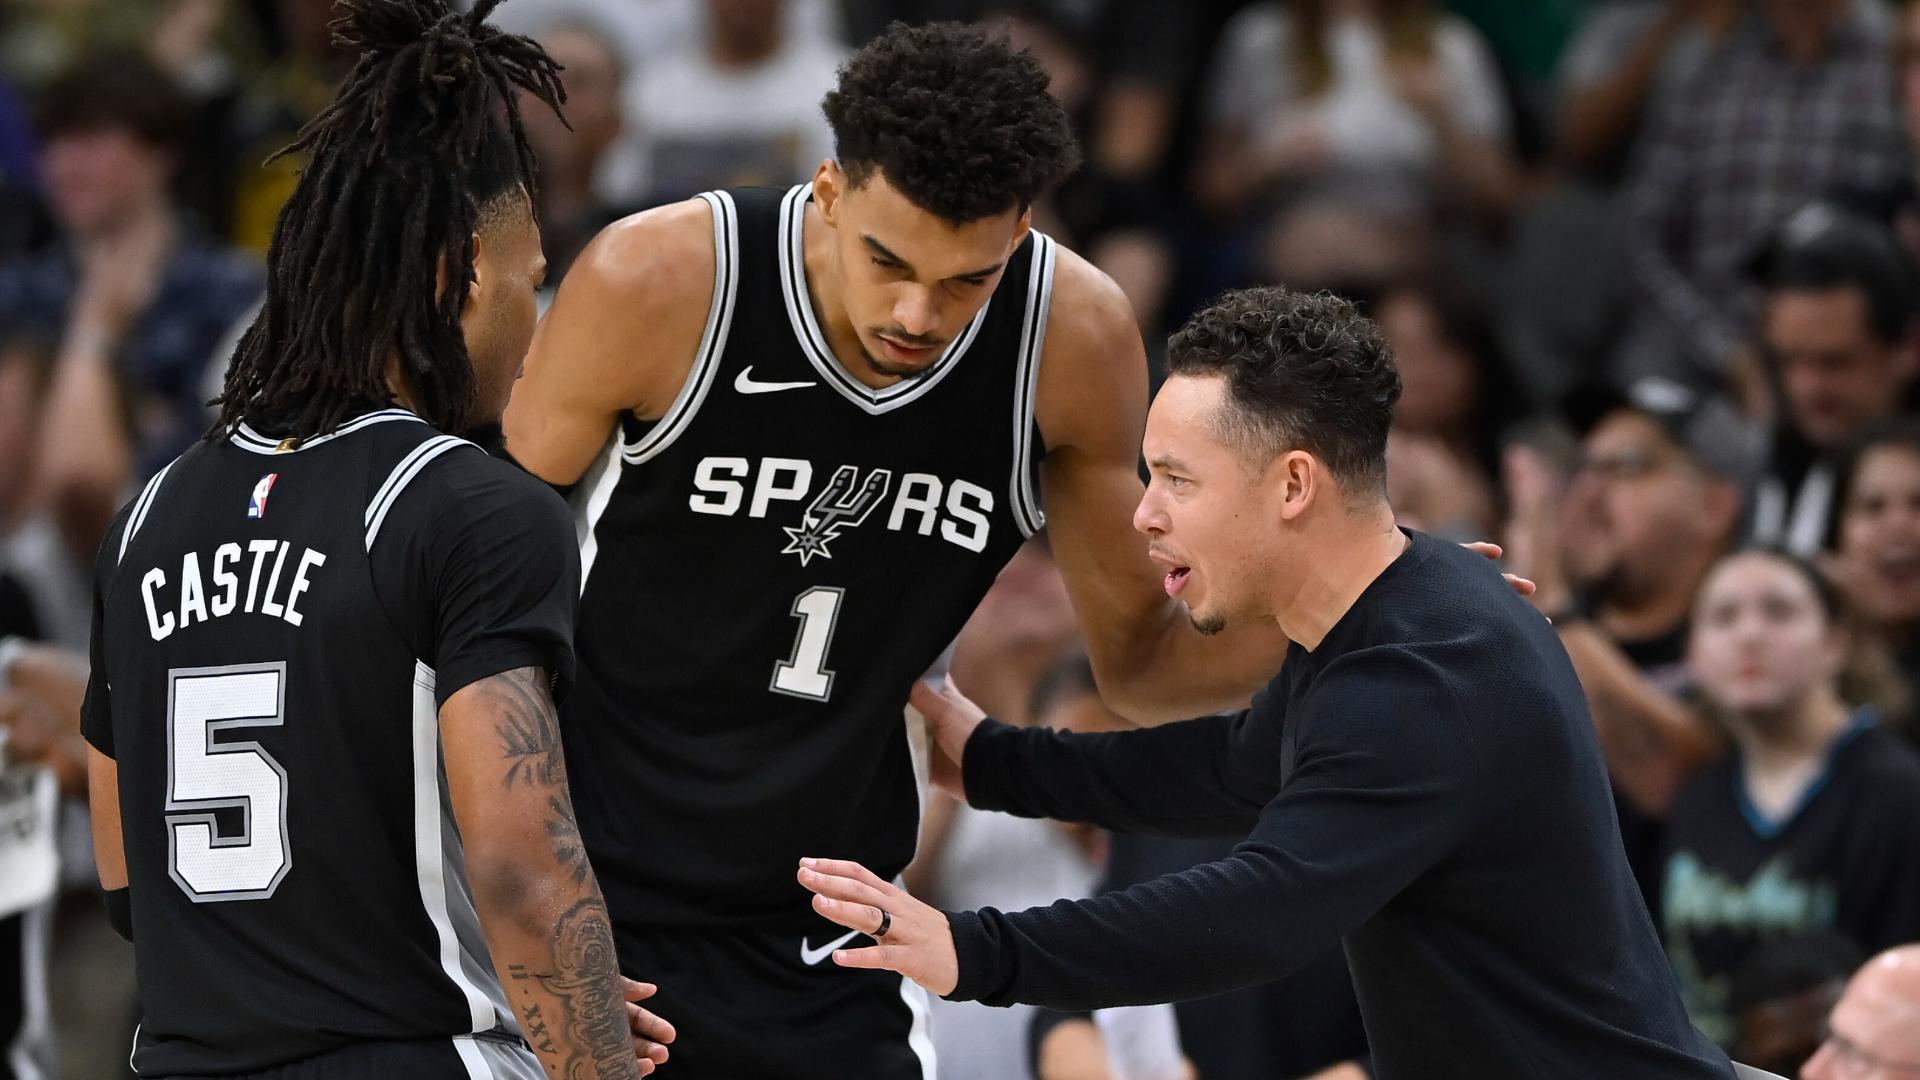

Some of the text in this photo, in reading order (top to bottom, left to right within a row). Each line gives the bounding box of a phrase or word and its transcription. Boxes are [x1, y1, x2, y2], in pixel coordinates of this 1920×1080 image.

[689, 456, 995, 567] SPURS
[141, 539, 327, 641] CASTLE
[769, 585, 845, 702] 1
[165, 661, 292, 903] 5
